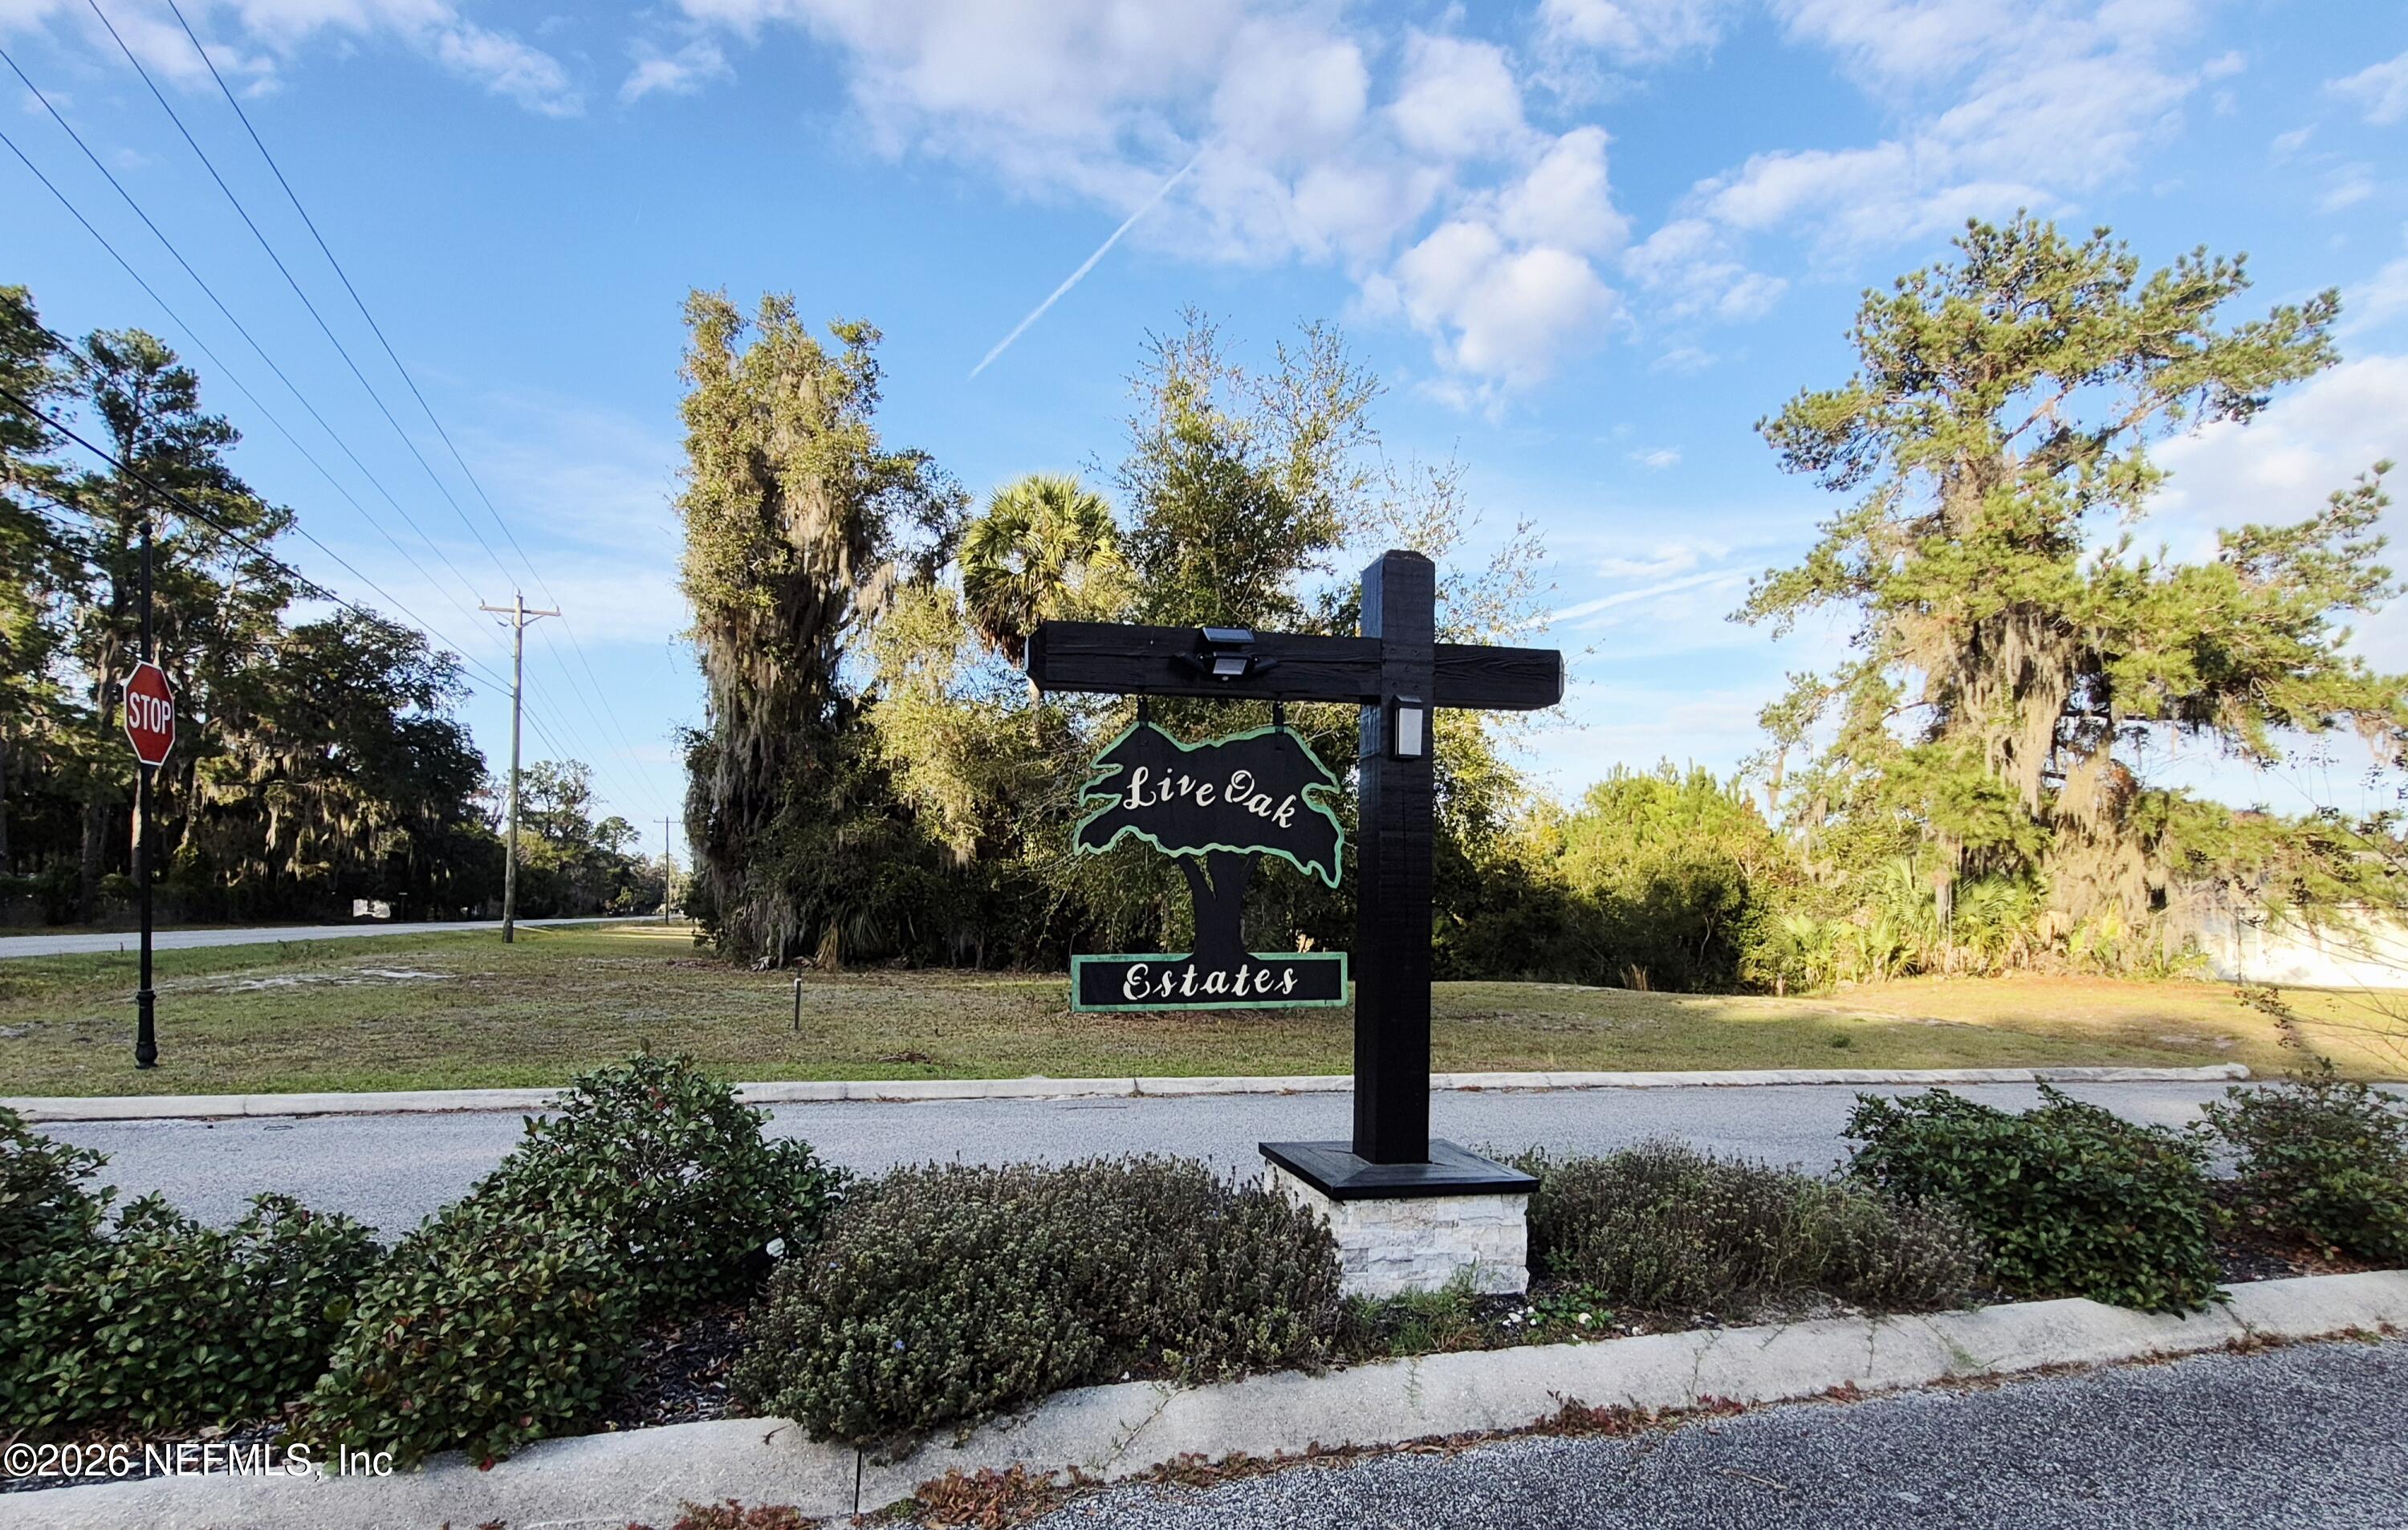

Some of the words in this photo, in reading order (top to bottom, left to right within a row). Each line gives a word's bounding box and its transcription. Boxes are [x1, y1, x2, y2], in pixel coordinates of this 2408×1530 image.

[128, 691, 172, 734] STOP
[1123, 766, 1216, 810] Live
[1224, 769, 1296, 828] Oak
[1123, 962, 1299, 1000] Estates
